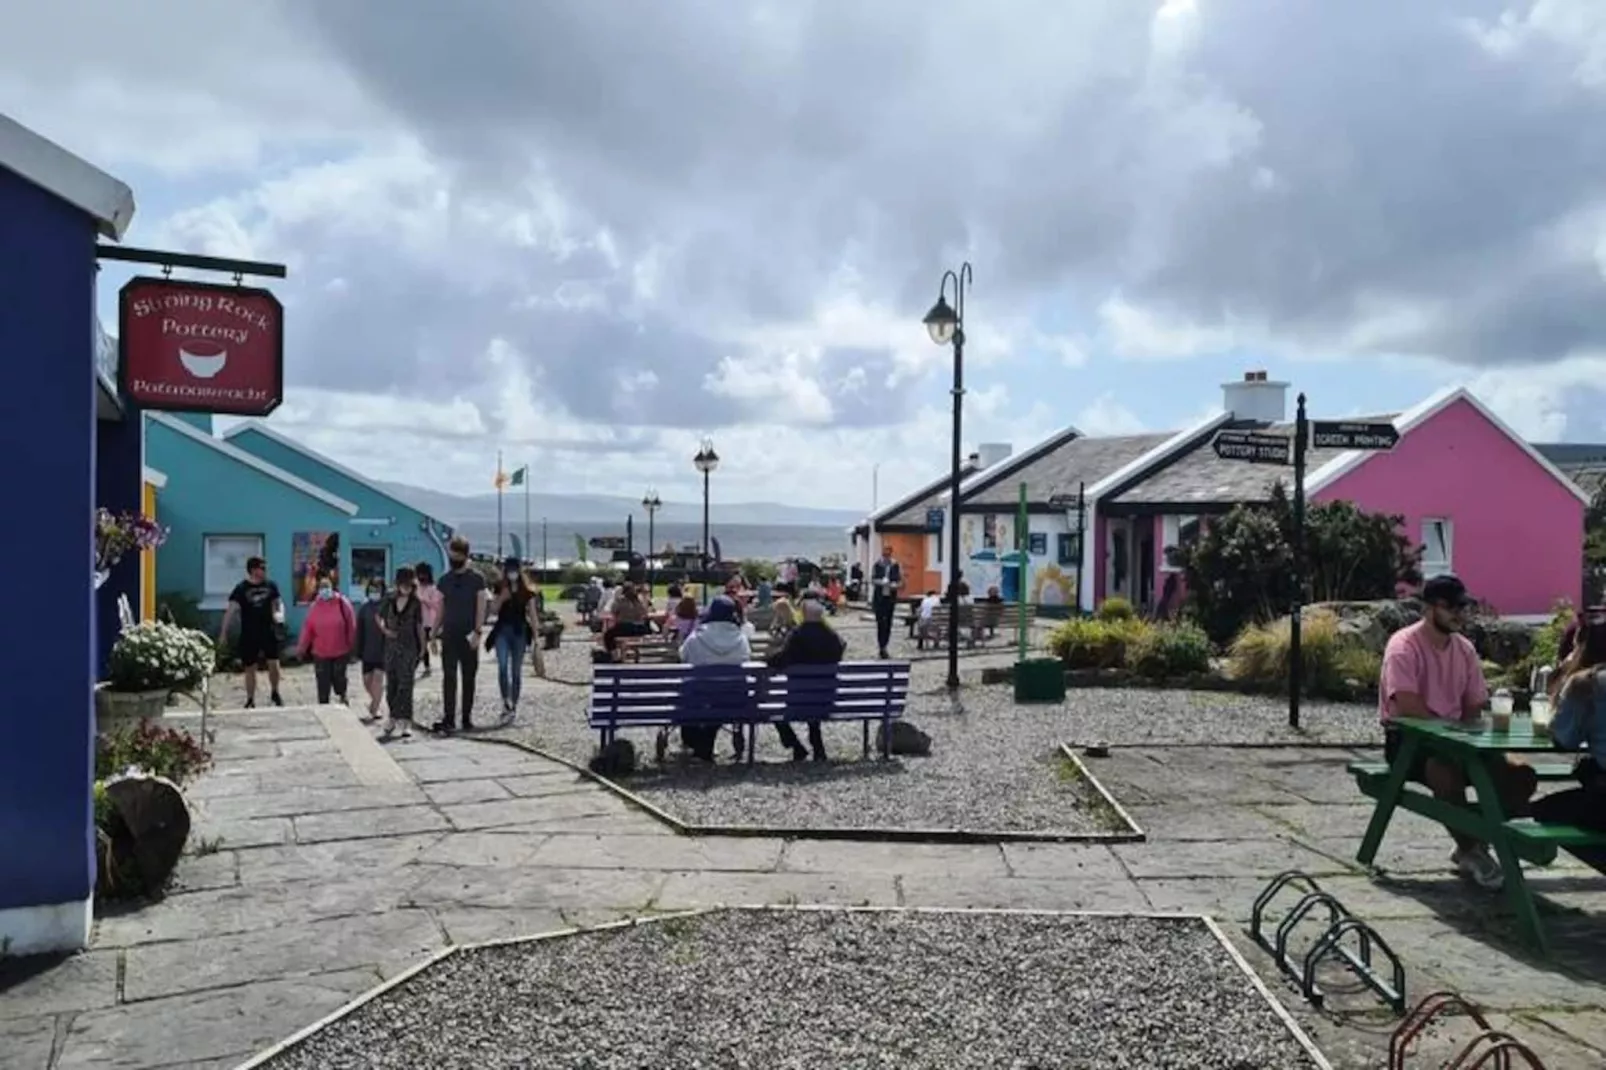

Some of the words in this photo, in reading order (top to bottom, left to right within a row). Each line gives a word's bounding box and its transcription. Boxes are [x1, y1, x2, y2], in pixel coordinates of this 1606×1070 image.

[217, 296, 269, 330] Rock
[162, 318, 249, 344] Pottery
[1219, 443, 1257, 457] POTTERY
[1259, 446, 1288, 460] STUDIO
